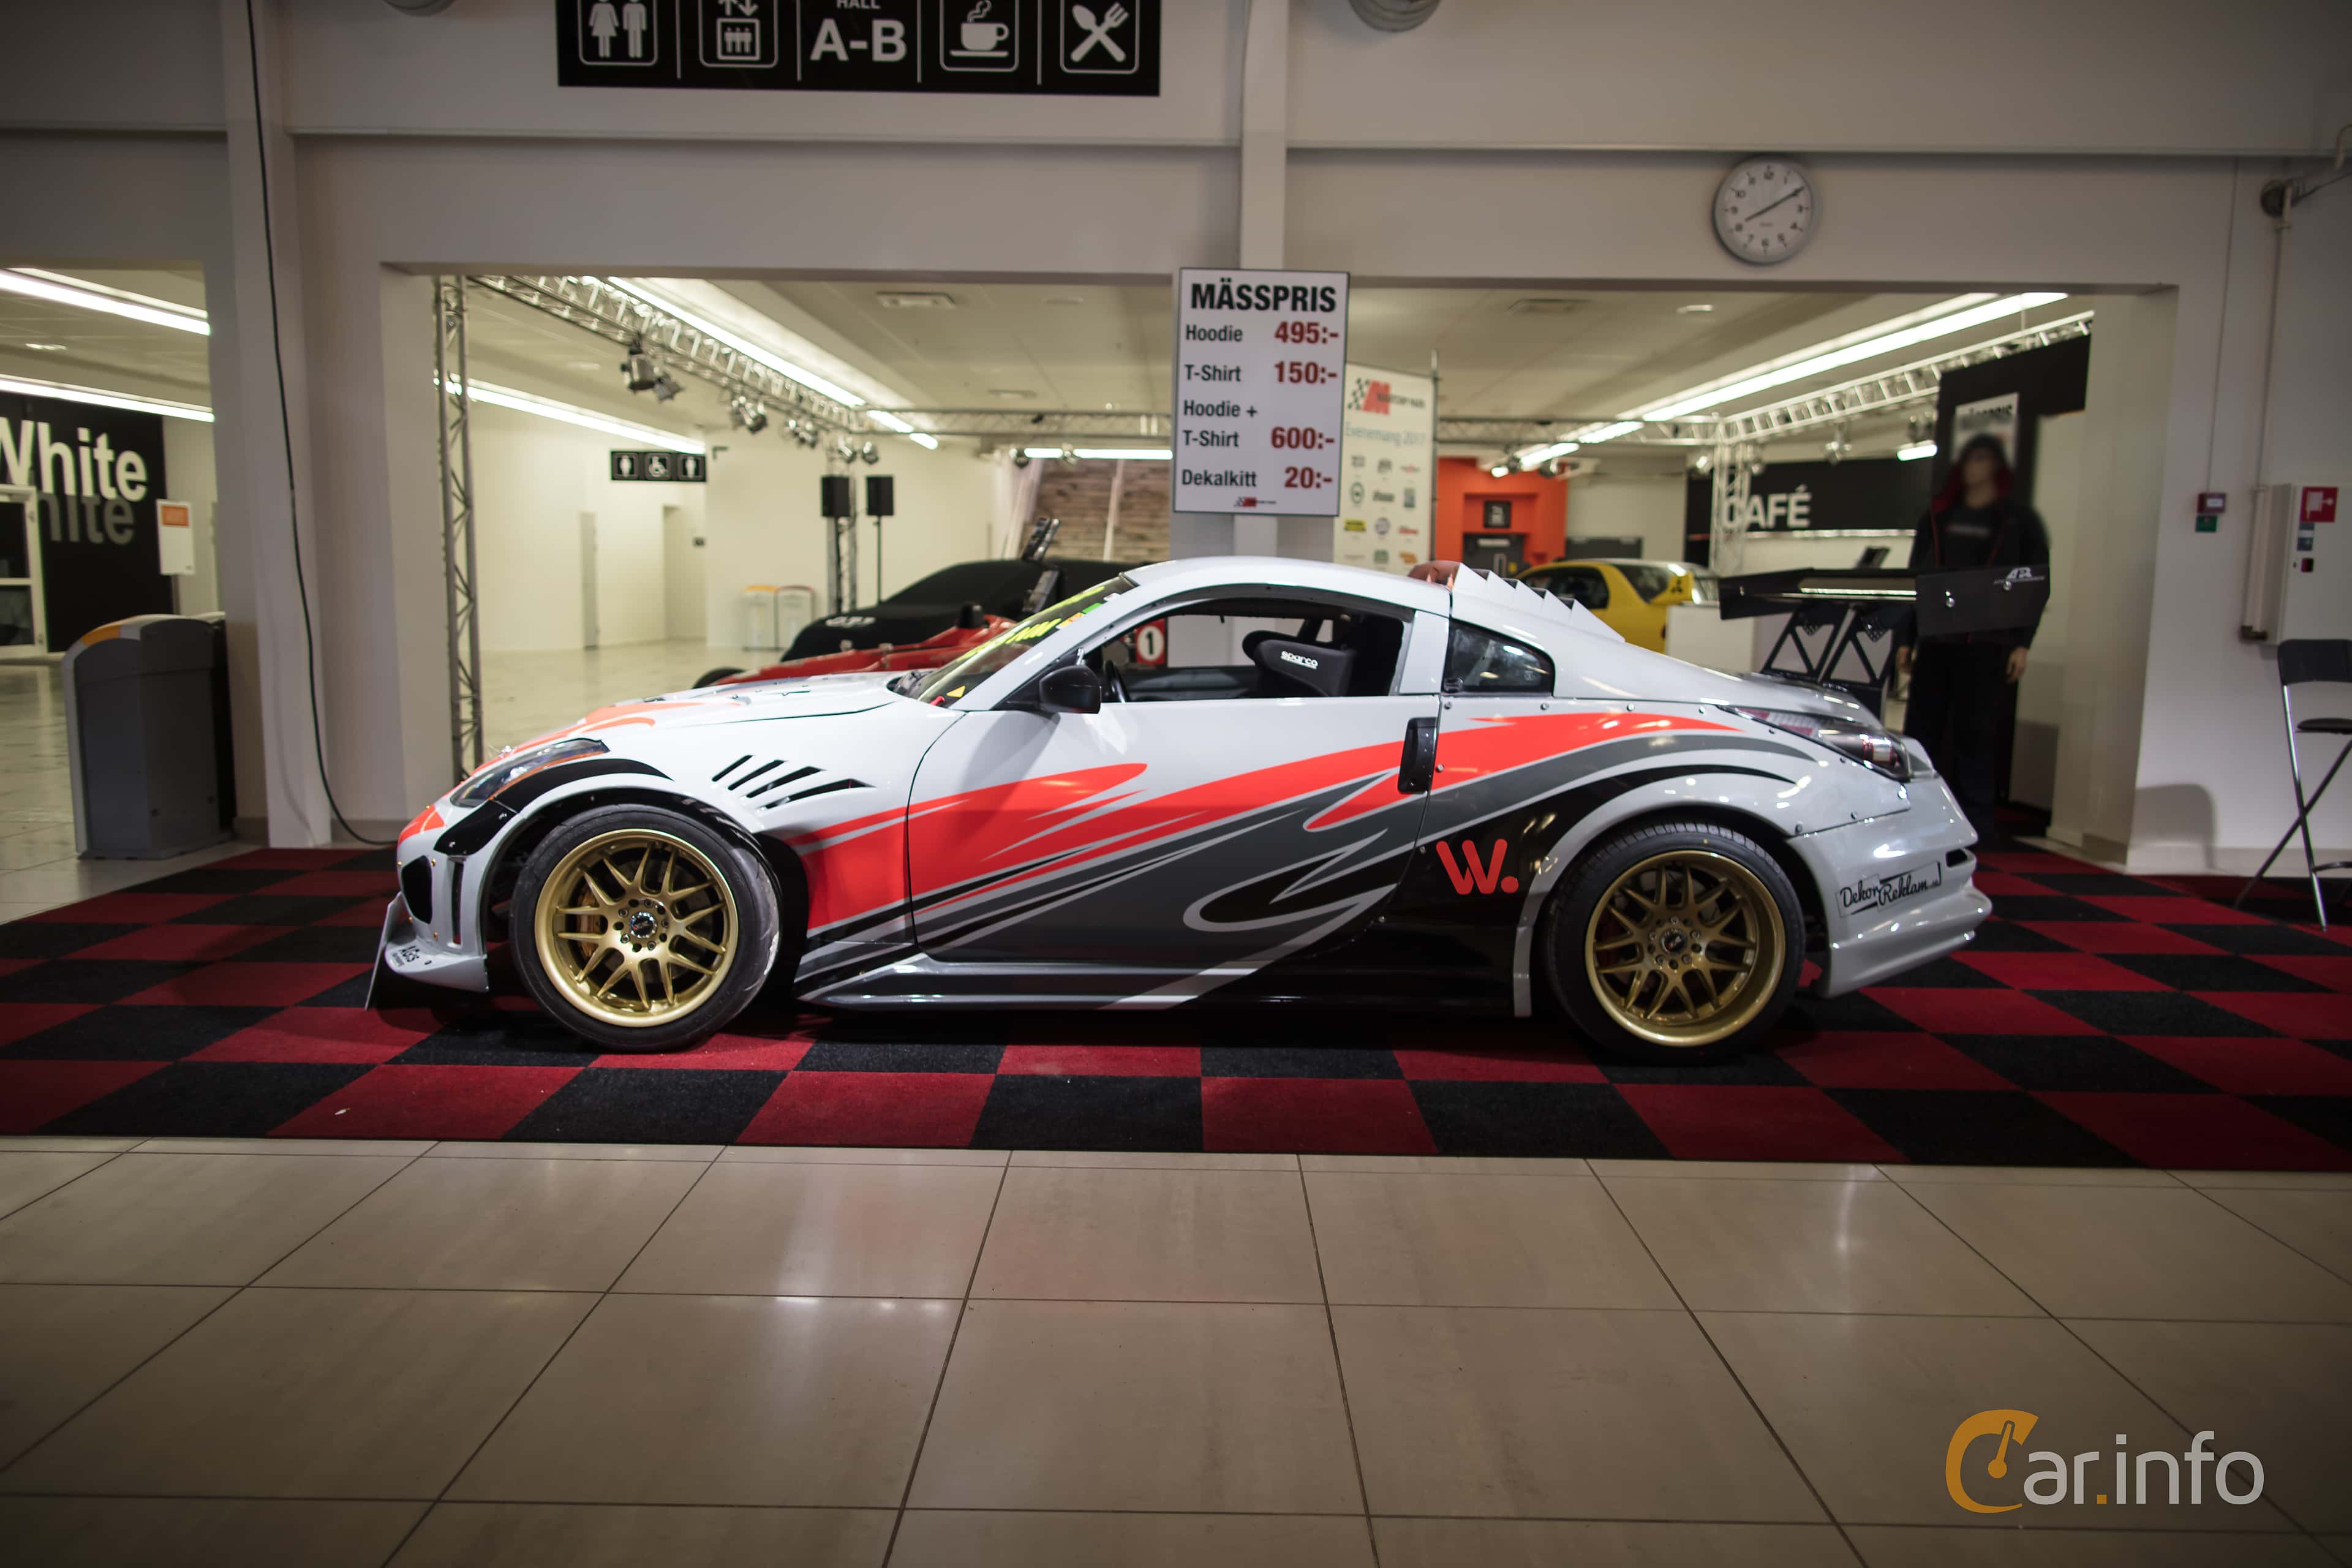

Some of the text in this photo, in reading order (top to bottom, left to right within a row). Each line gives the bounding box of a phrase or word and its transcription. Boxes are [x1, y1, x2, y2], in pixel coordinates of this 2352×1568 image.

[837, 0, 880, 9] HALL
[810, 18, 907, 62] A-B
[1191, 277, 1336, 312] MÄSSPRIS
[1186, 321, 1339, 344] Hoodie 495:-
[1185, 361, 1337, 384] T-Shirt 150:-
[1183, 399, 1258, 417] Hoodie +
[1183, 426, 1335, 450] T-Shirt 600:-
[1182, 466, 1333, 489] Dekalkitt 20:-
[1146, 631, 1153, 655] 1
[1281, 650, 1318, 667] sparco
[1840, 880, 1880, 908] Dekor
